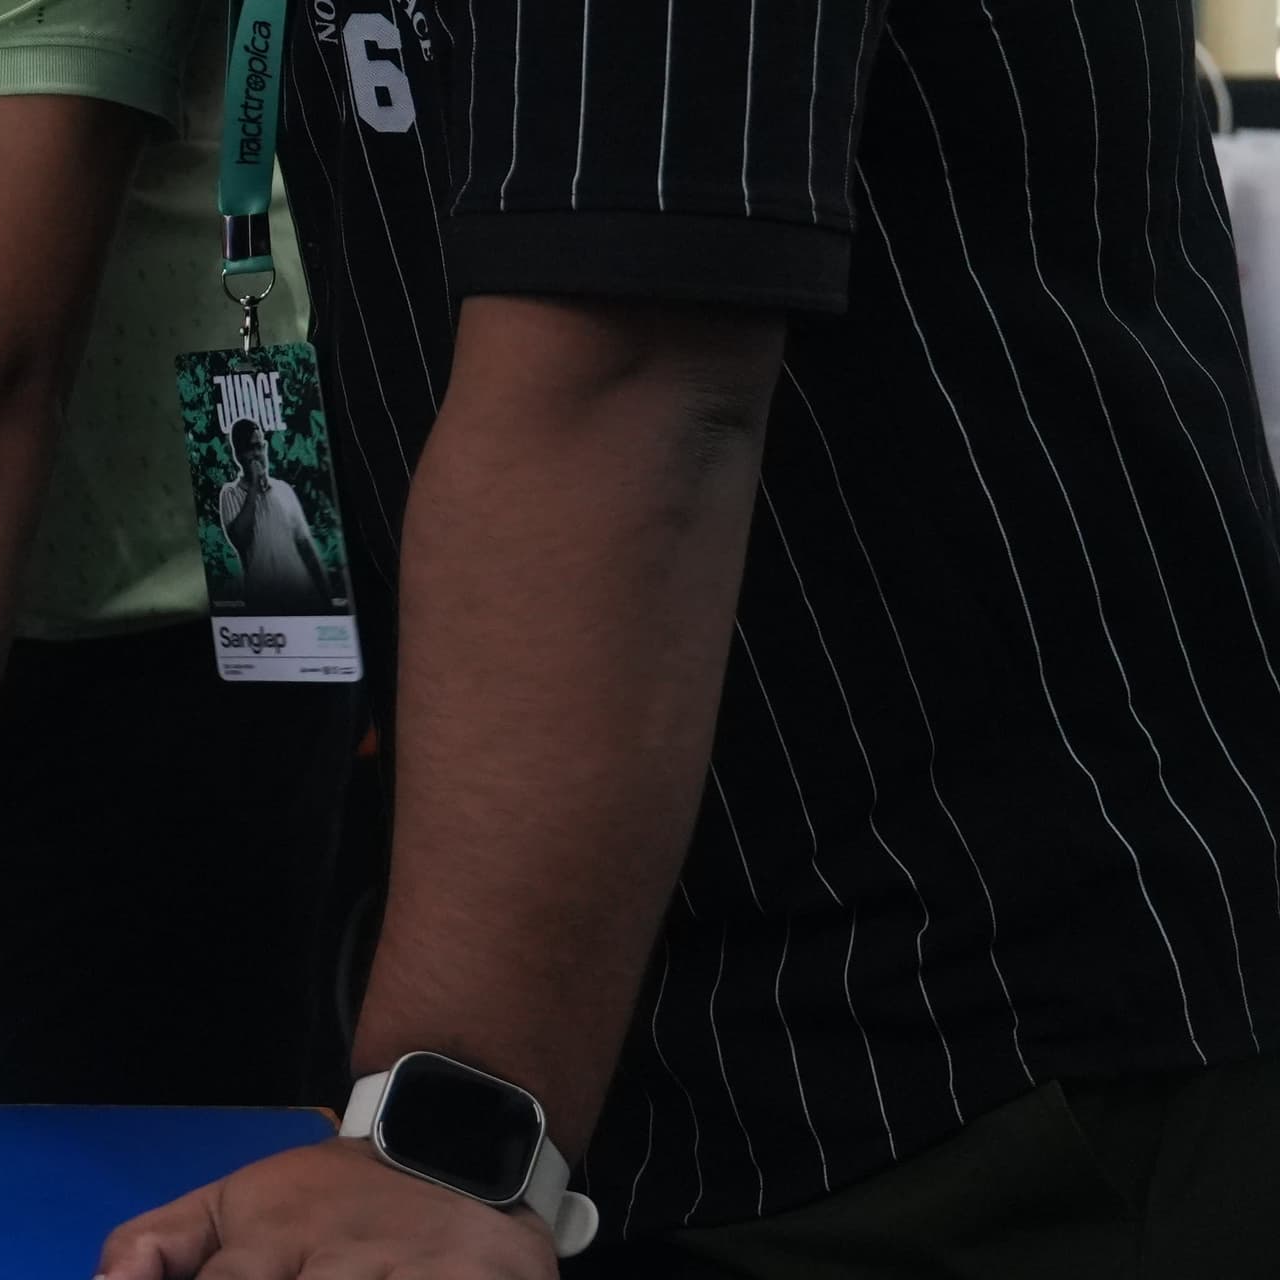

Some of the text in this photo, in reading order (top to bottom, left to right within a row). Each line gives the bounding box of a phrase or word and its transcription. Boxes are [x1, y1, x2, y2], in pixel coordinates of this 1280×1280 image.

[235, 19, 273, 166] hacktropica
[341, 12, 417, 134] 6
[212, 370, 288, 435] JUDGE
[219, 626, 287, 655] Sanglap
